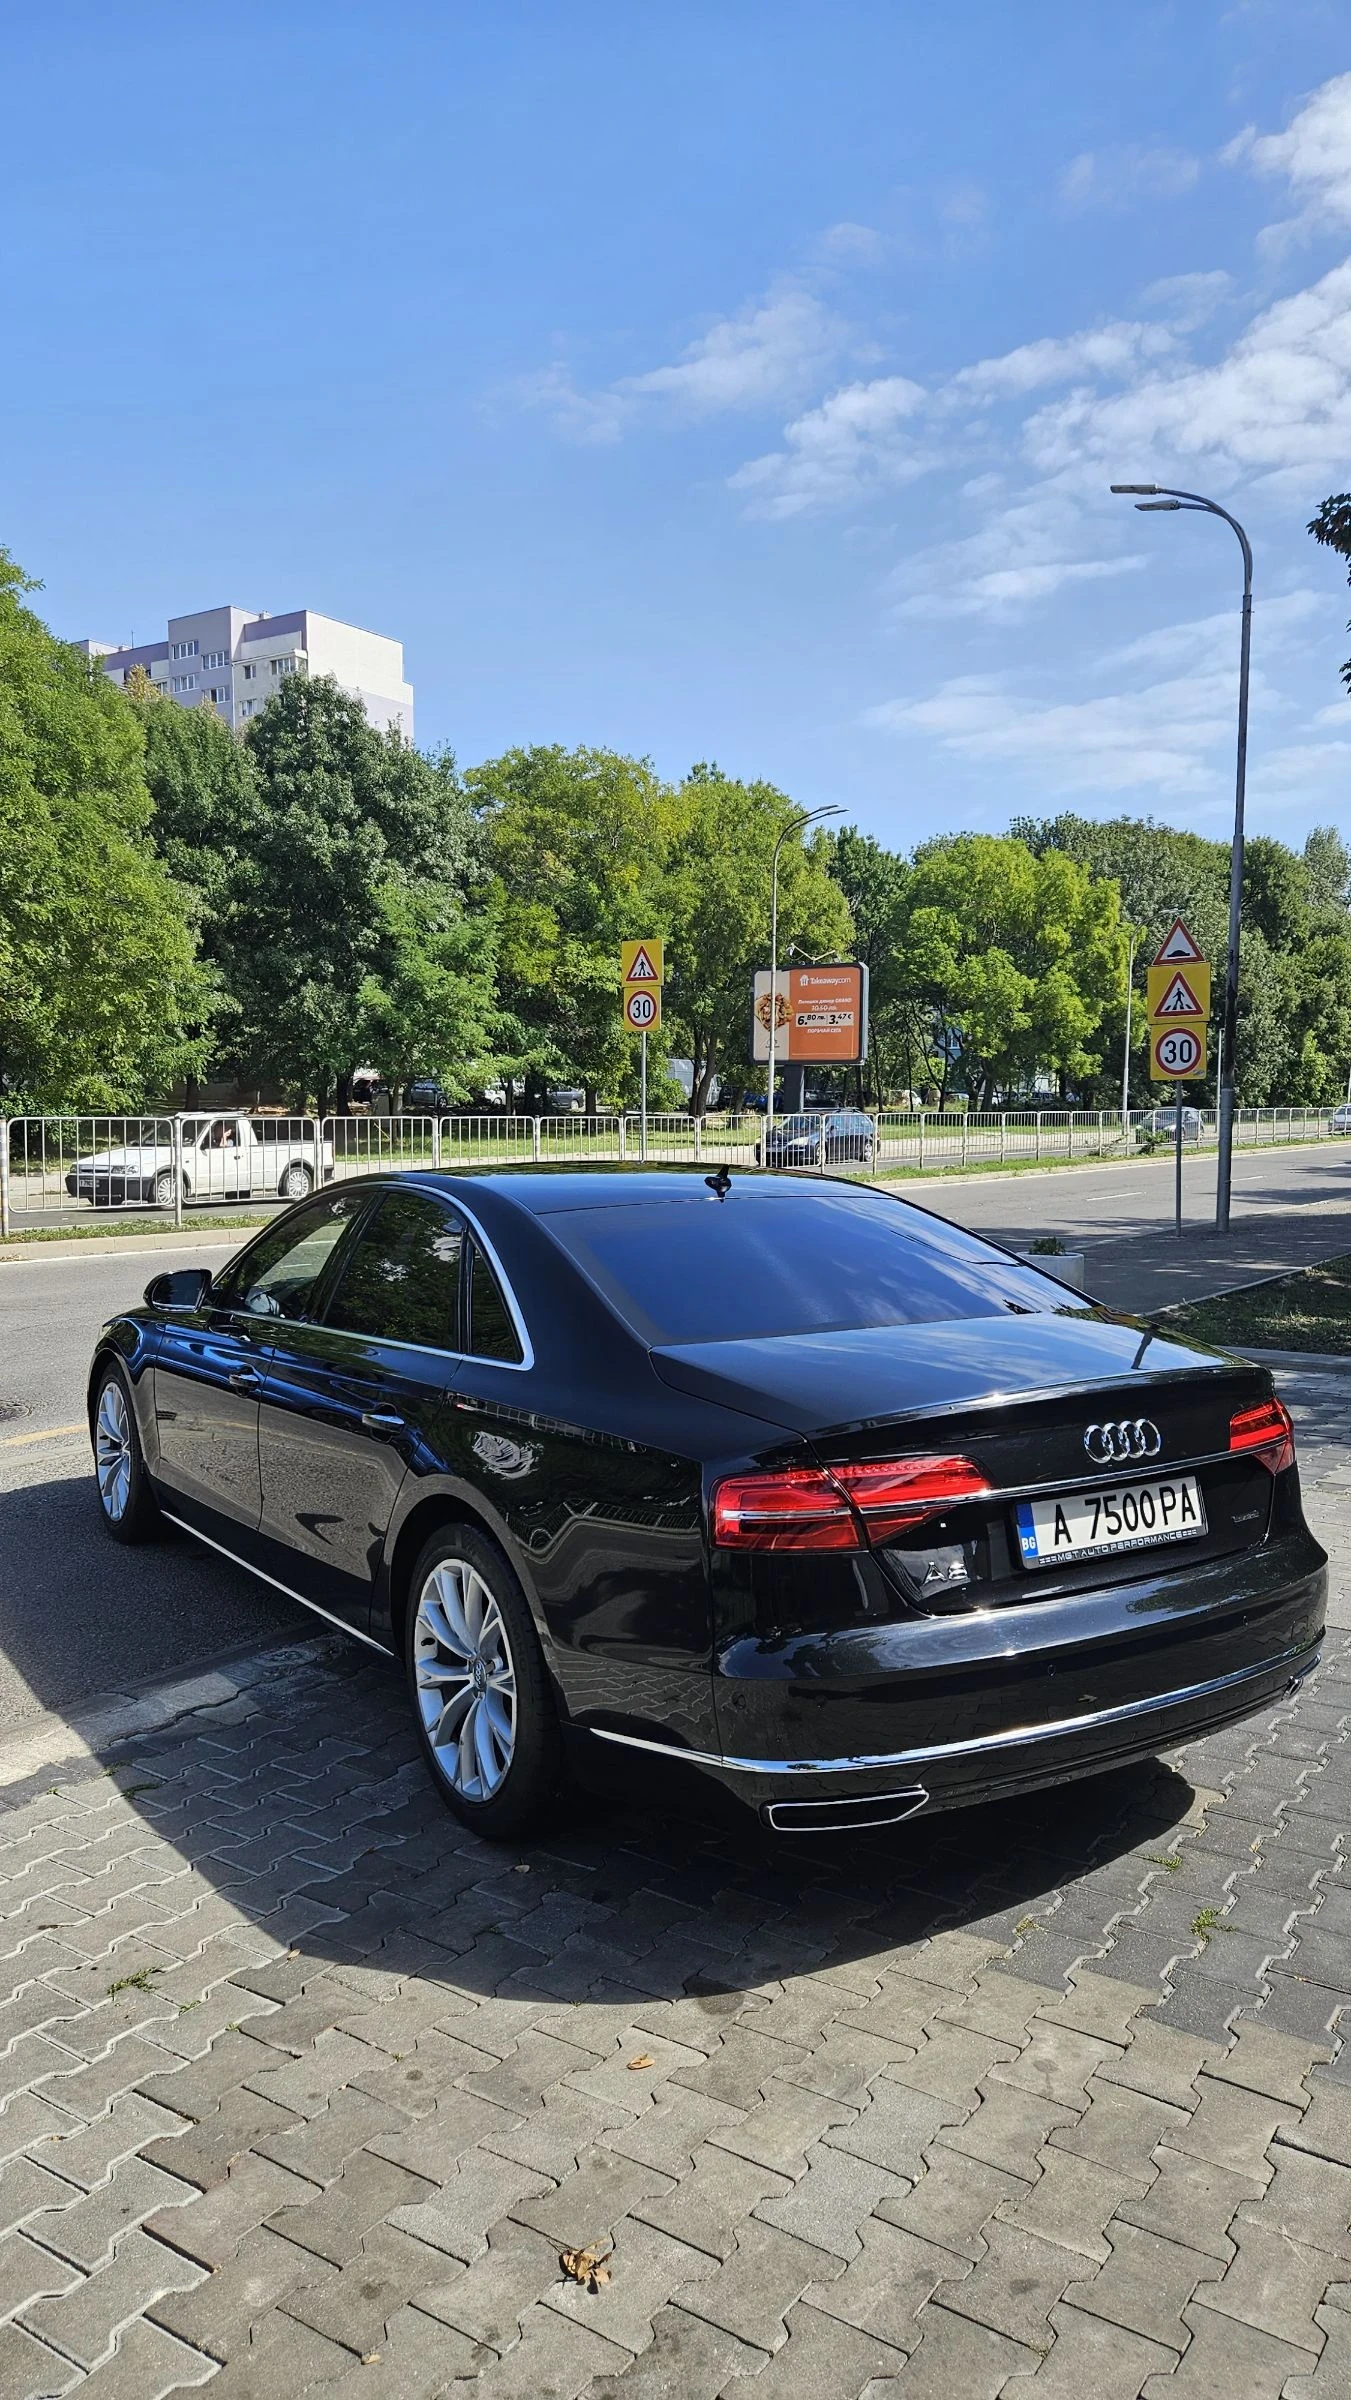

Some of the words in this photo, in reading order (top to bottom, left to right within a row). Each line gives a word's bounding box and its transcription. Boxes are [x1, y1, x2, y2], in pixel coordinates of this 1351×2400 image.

[632, 1000, 651, 1018] 30
[1164, 1039, 1193, 1064] 30
[1054, 1503, 1073, 1546] A
[1084, 1489, 1157, 1540] 7500
[1159, 1483, 1197, 1526] PA
[1021, 1536, 1037, 1551] BG
[1081, 1545, 1109, 1557] AUTO
[1110, 1530, 1183, 1552] PERFORMANCE
